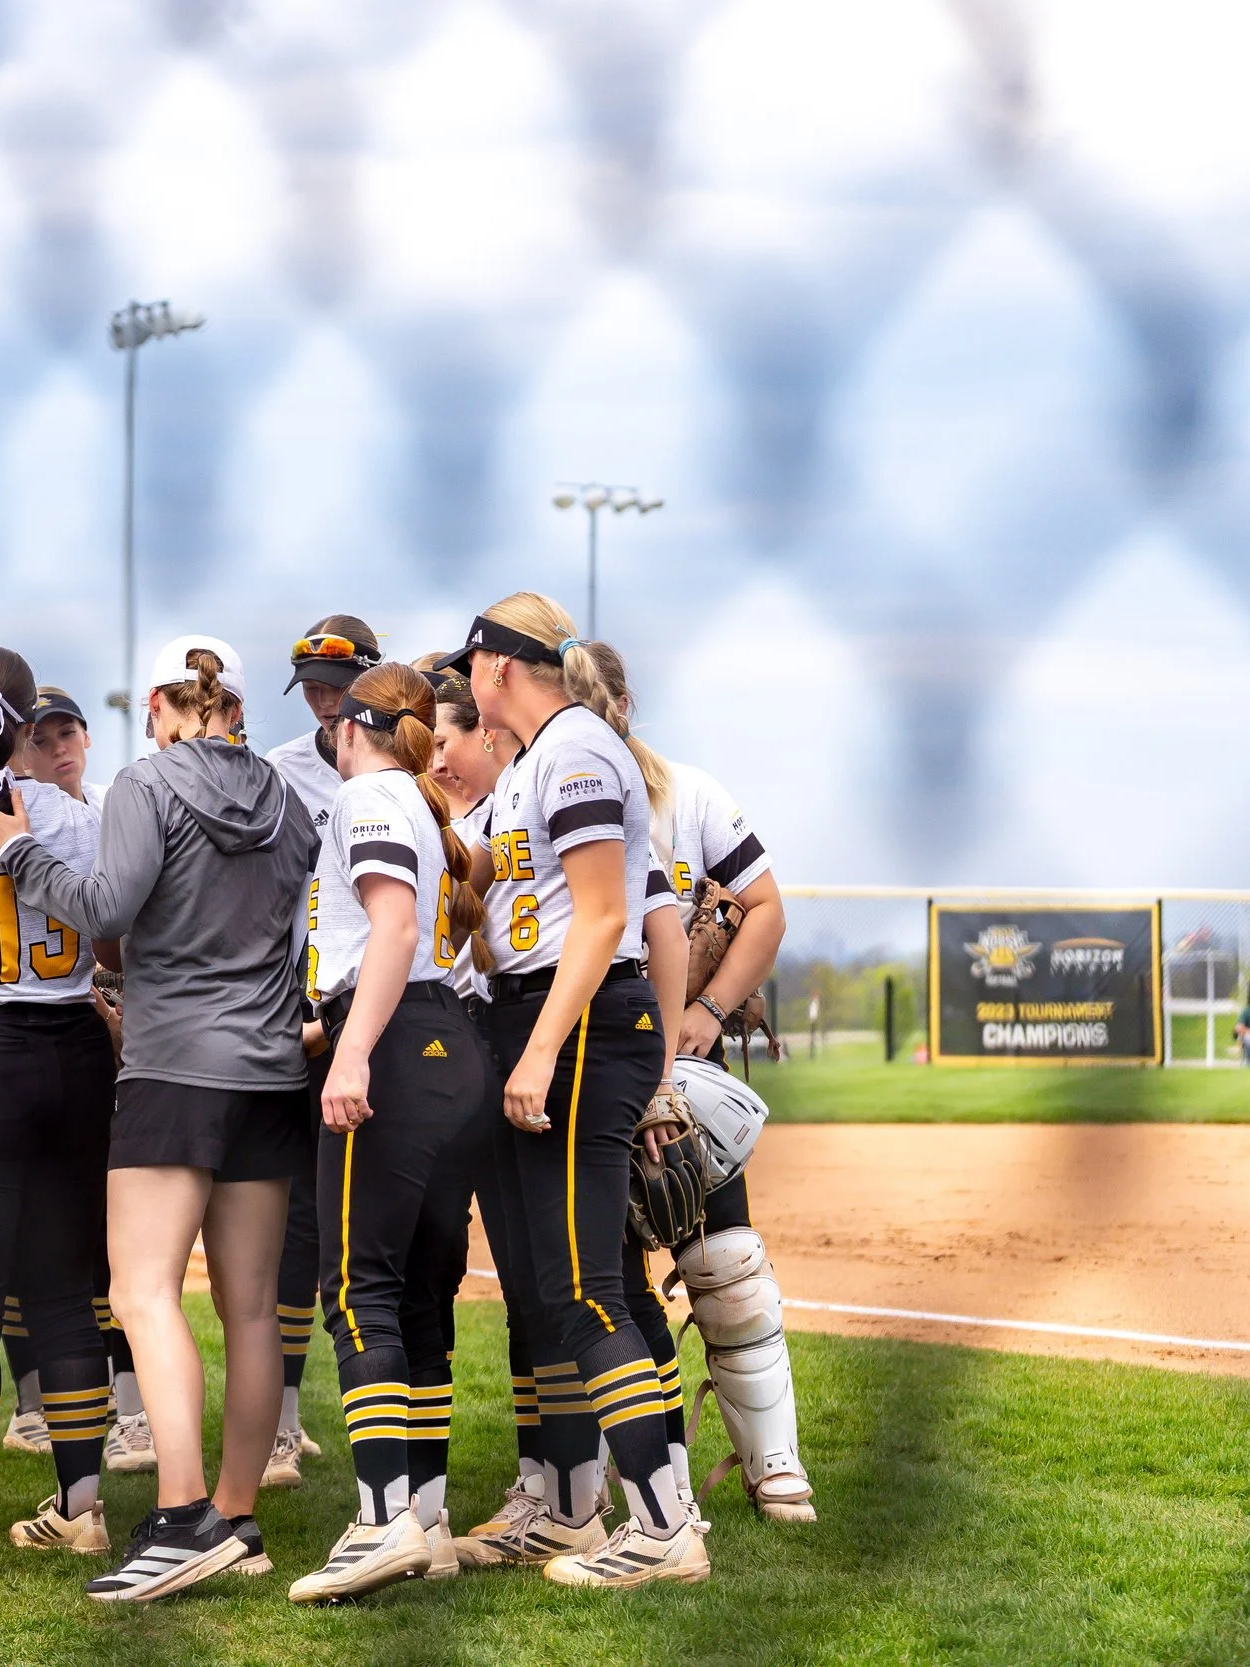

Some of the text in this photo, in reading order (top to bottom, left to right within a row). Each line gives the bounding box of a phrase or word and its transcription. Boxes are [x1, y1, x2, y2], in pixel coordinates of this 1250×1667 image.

[559, 778, 603, 795] HORIZON
[510, 894, 540, 951] 6
[1051, 949, 1125, 964] HORIZON
[1019, 1001, 1115, 1021] TOURNAMENT
[983, 1022, 1110, 1049] CHAMPIONS
[422, 1049, 448, 1057] adidas
